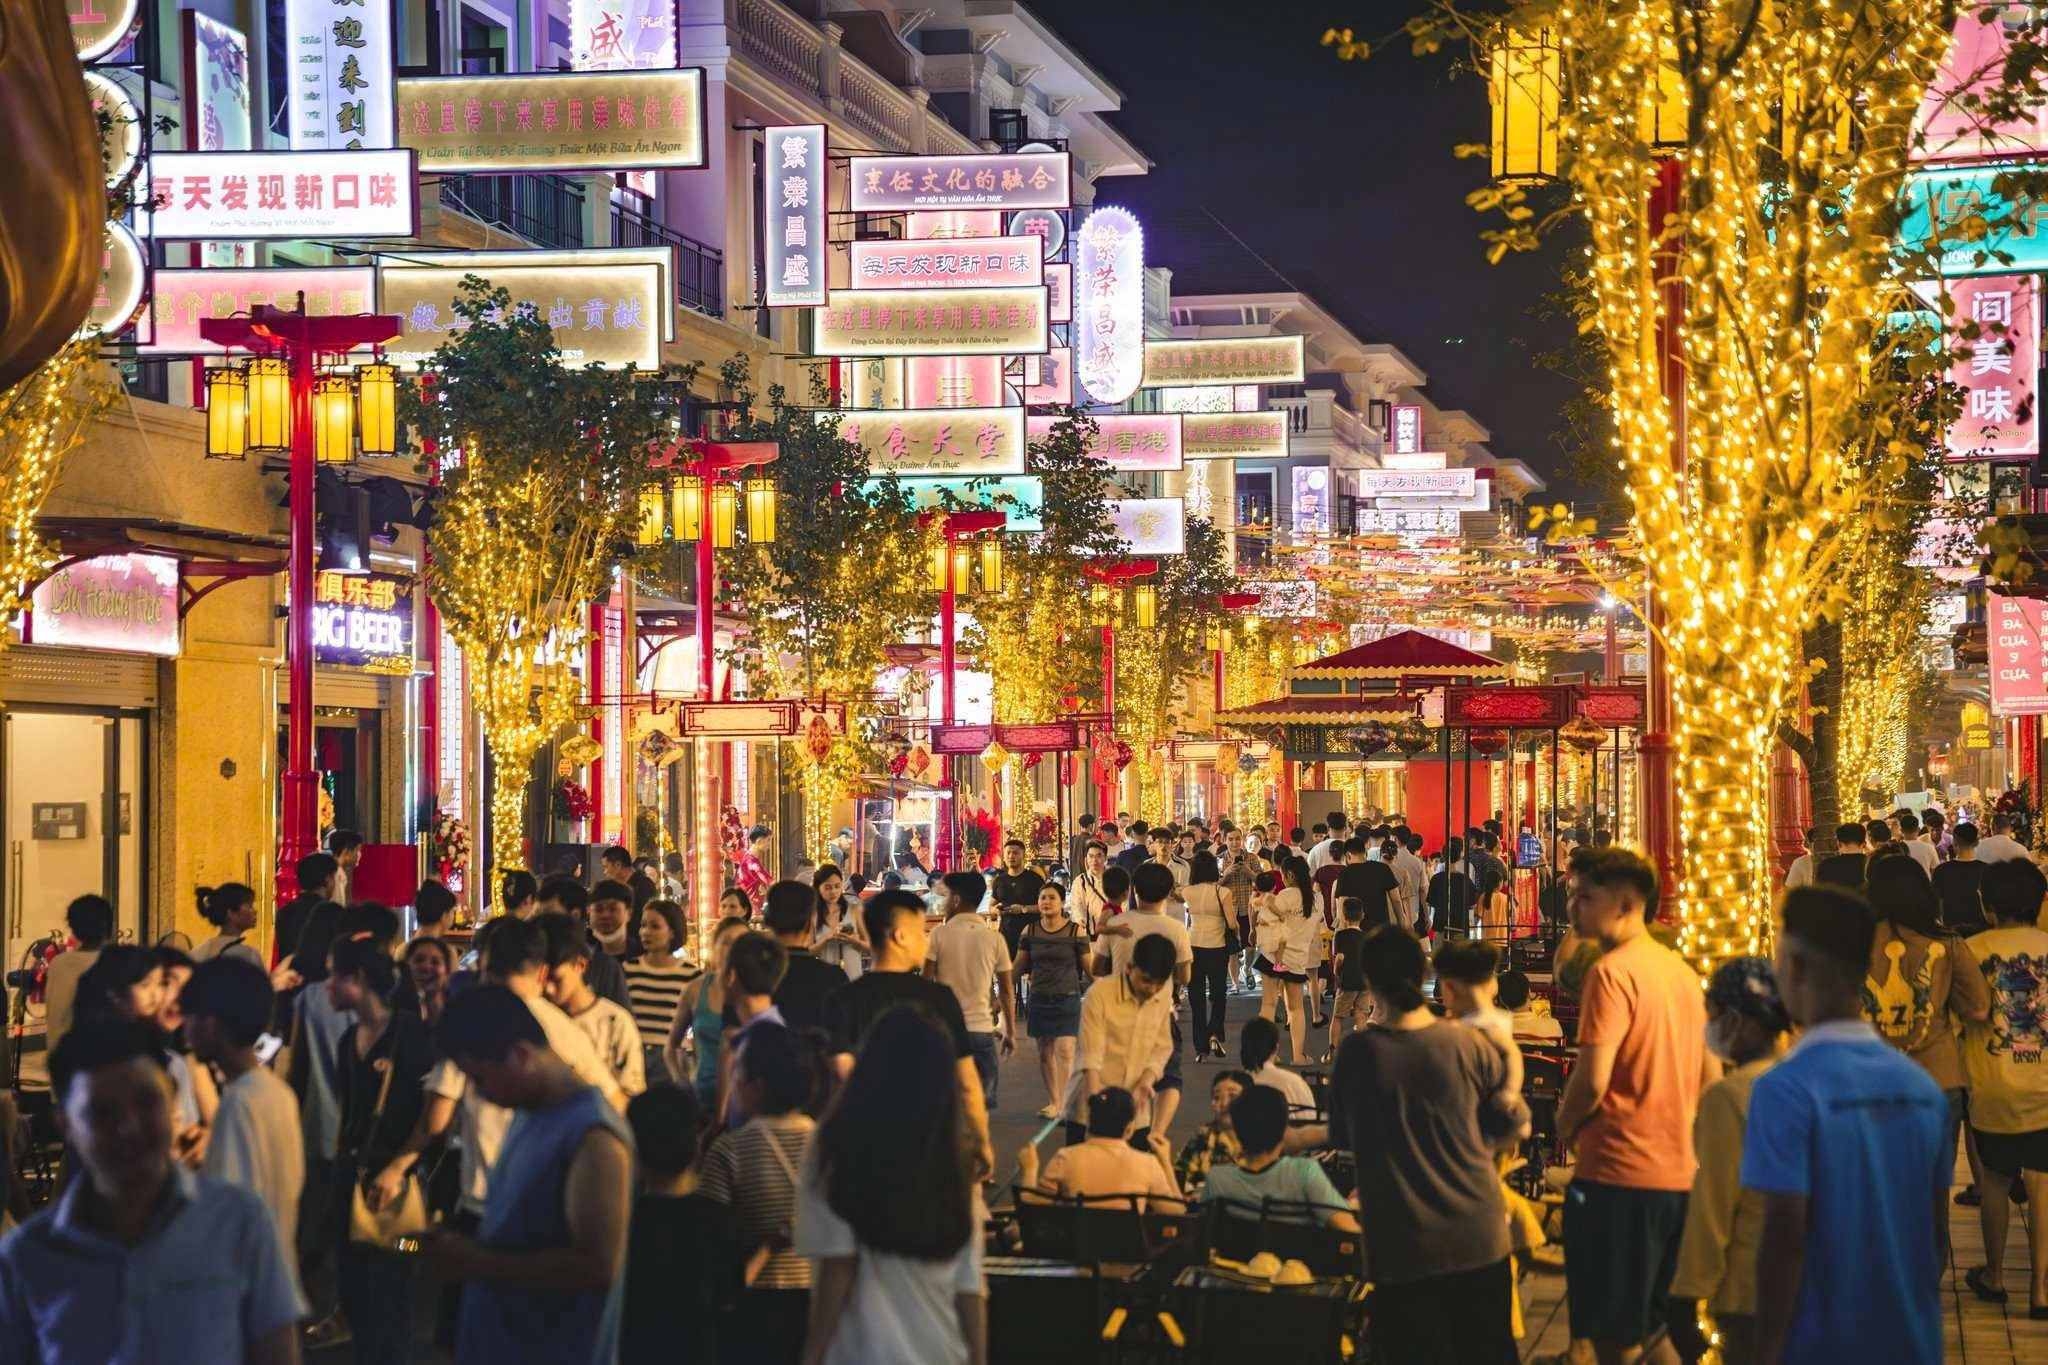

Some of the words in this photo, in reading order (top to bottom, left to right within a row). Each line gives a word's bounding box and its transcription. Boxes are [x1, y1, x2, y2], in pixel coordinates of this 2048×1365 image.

[332, 0, 369, 149] 迎来到
[634, 139, 650, 153] Ăn
[652, 141, 681, 154] Ngon
[862, 253, 1030, 277] 每天发现新口味
[349, 608, 404, 655] BEER
